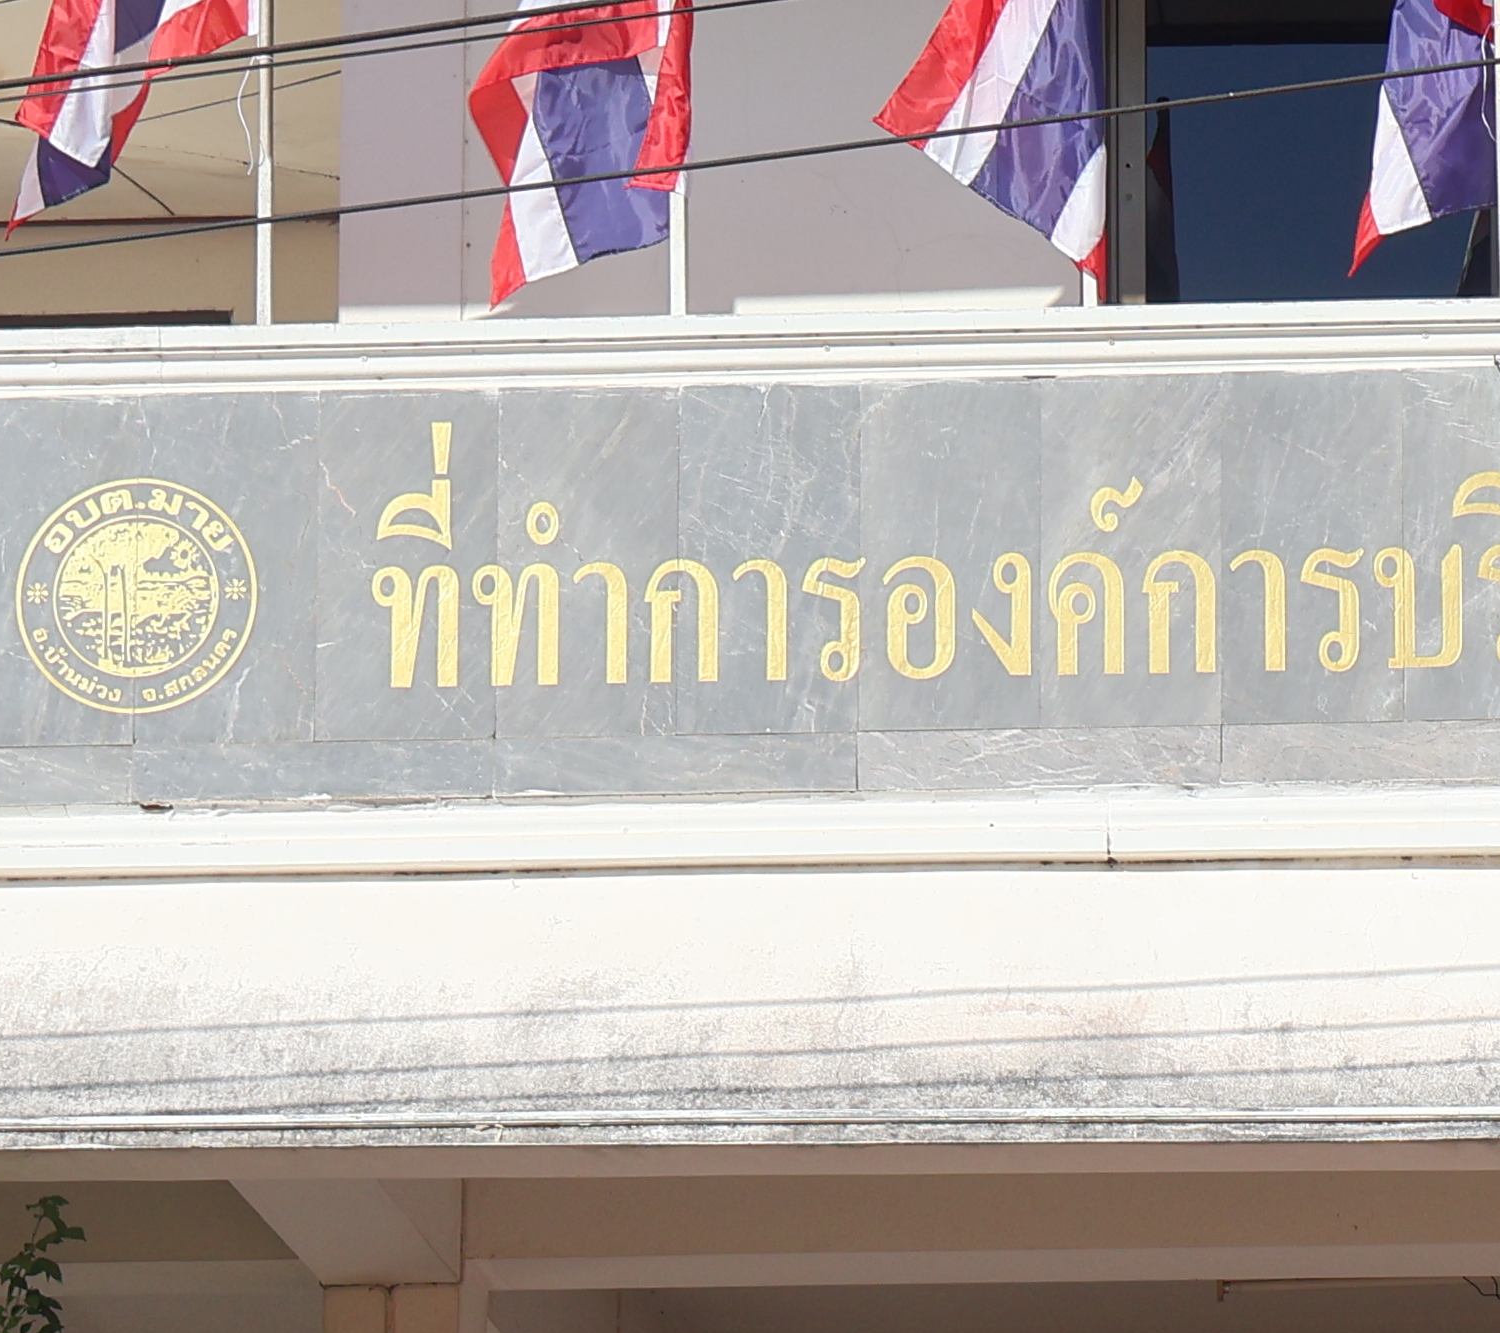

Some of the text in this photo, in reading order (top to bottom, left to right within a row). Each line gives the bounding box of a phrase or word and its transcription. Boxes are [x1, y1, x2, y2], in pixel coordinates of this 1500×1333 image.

[44, 488, 234, 554] อบต.มาย
[32, 627, 238, 703] อ.บ้านม่วง จ.สกลนคร
